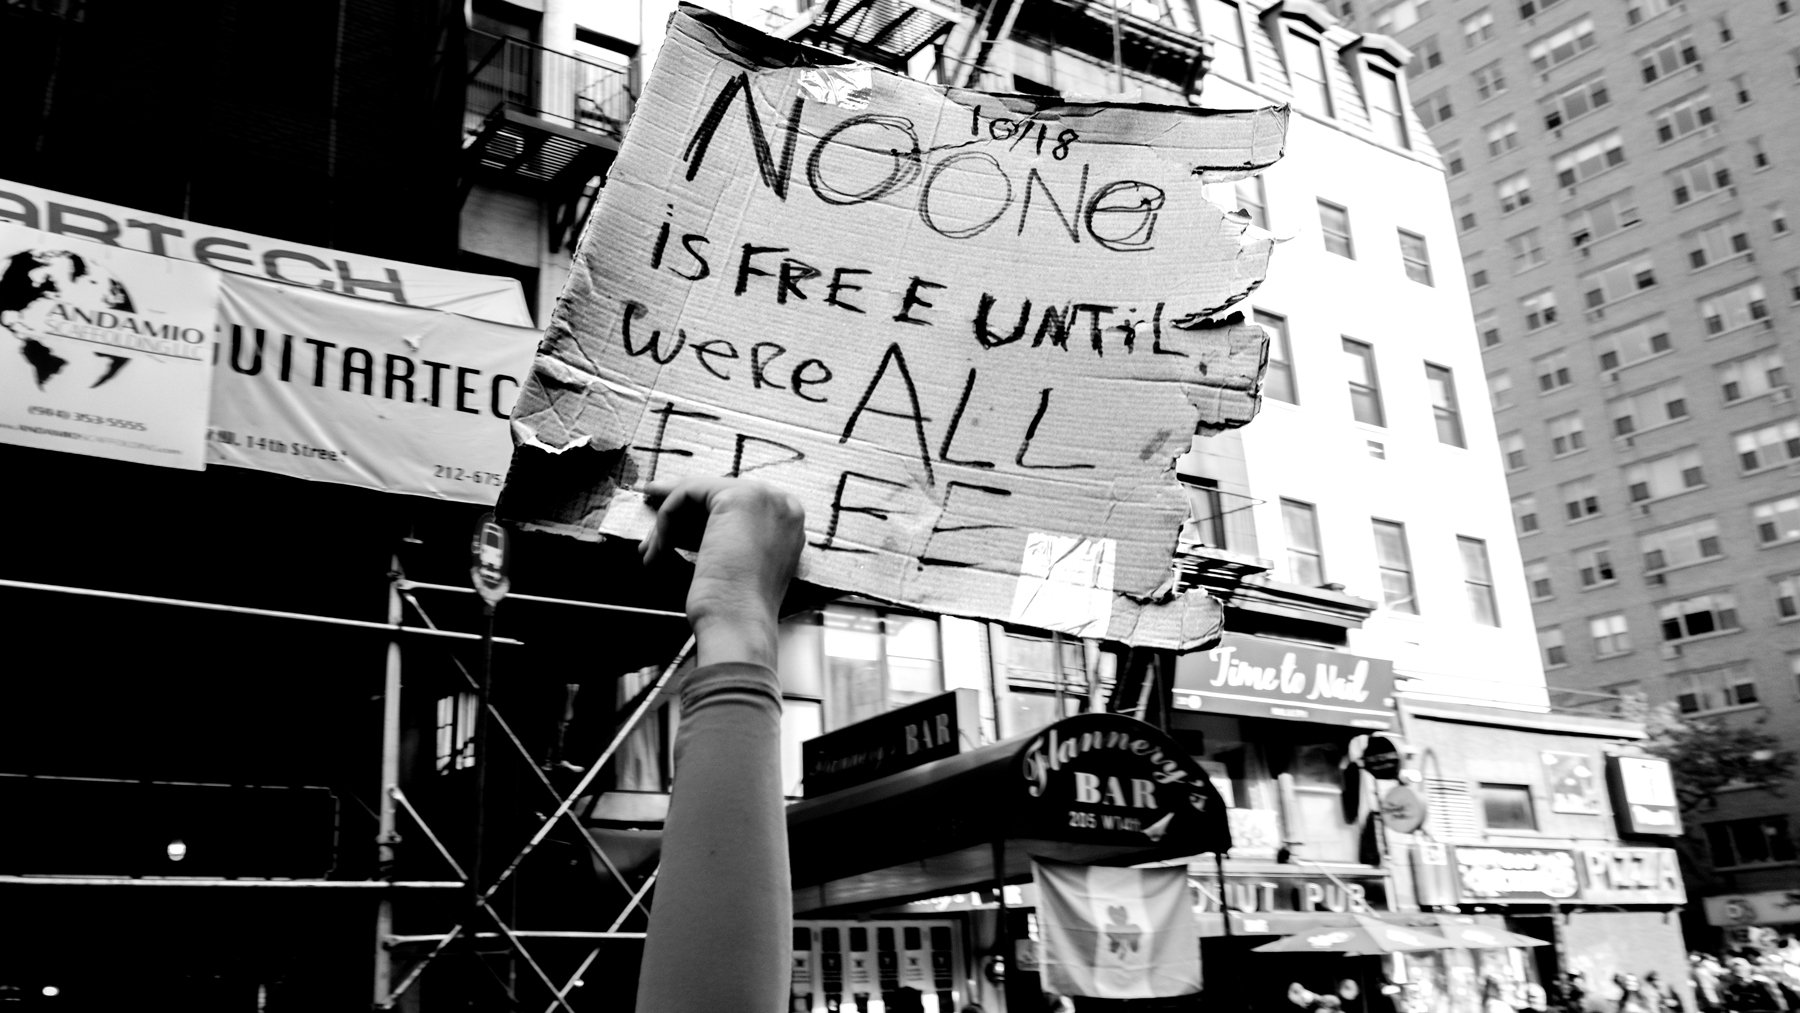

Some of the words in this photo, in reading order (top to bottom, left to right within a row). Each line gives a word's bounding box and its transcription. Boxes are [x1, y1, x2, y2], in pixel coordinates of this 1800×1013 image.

[684, 71, 922, 206] NO
[733, 243, 948, 327] FREE
[47, 303, 205, 345] ANDAMIO
[211, 323, 520, 421] UITARTEC
[840, 342, 1096, 488] ALL
[1209, 646, 1280, 691] Time
[1279, 651, 1307, 694] to
[1305, 659, 1370, 703] Nail
[905, 713, 951, 755] BAR
[1073, 771, 1159, 810] BAR
[1068, 810, 1097, 829] 205
[1305, 881, 1367, 914] PUB
